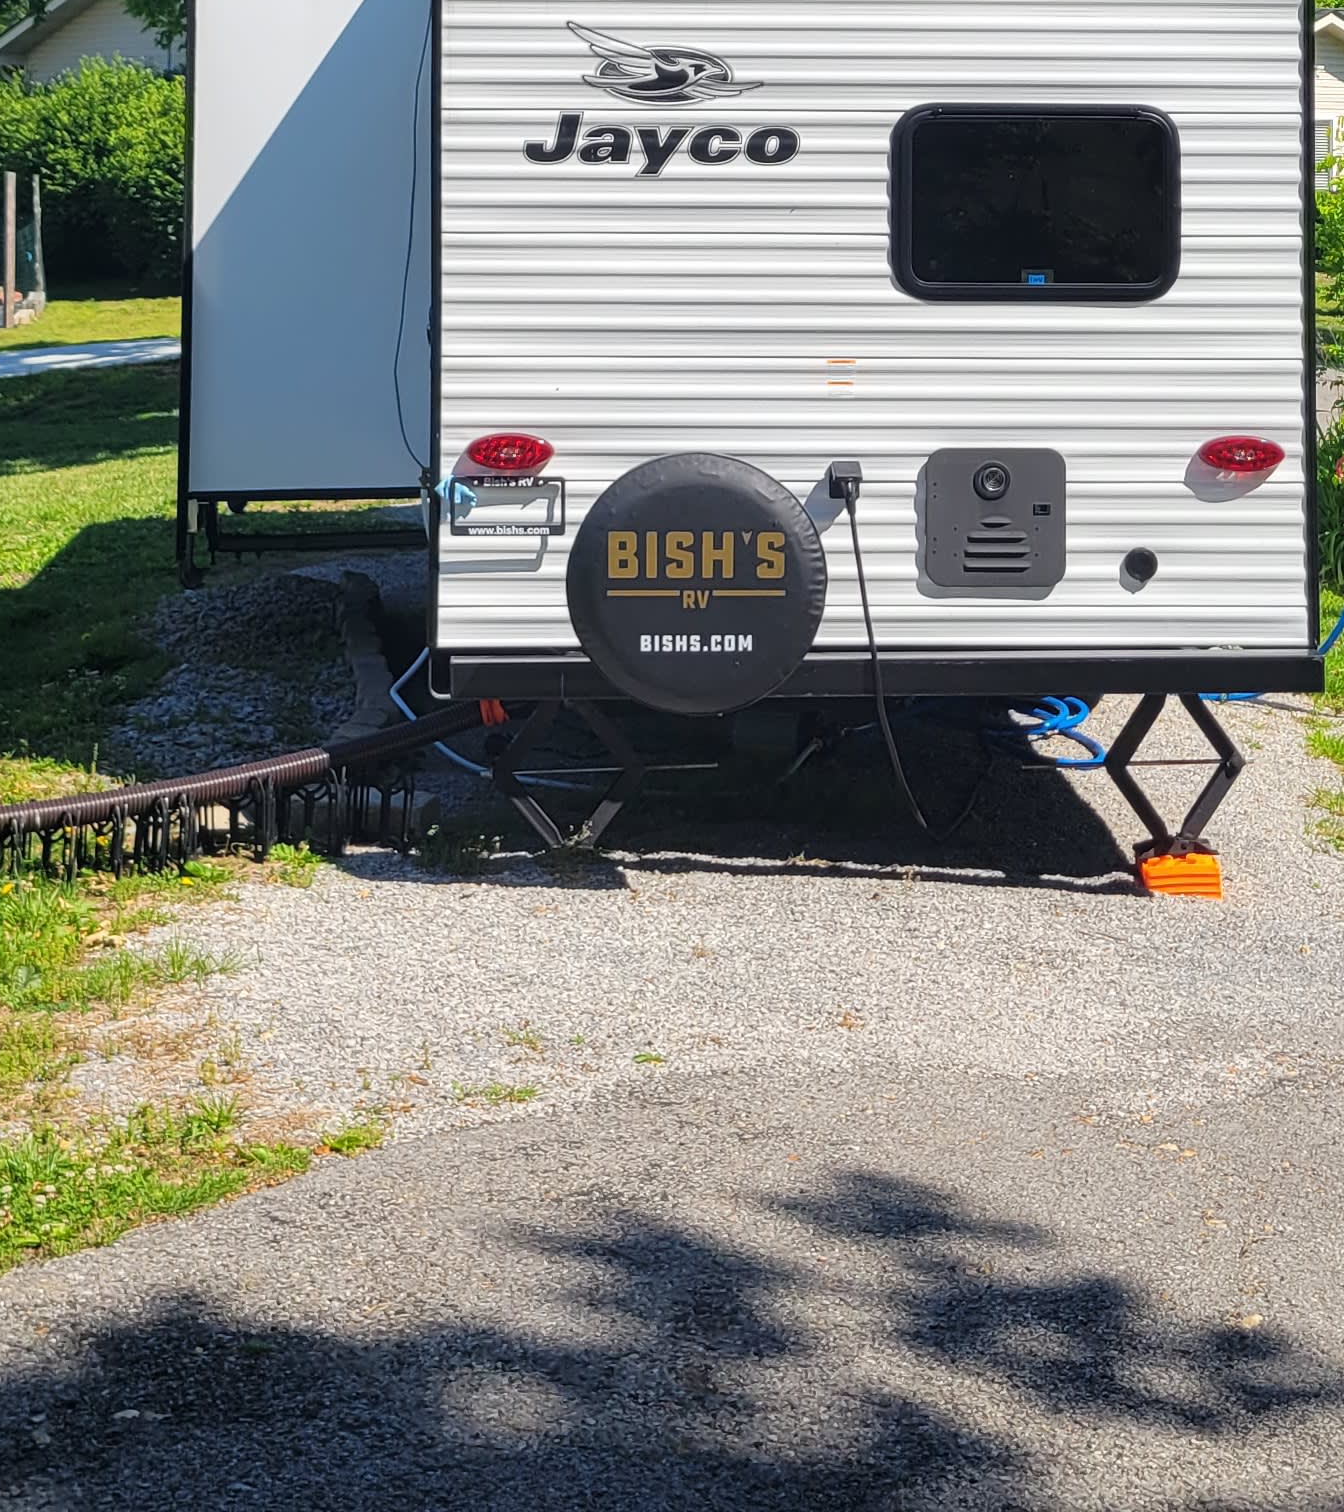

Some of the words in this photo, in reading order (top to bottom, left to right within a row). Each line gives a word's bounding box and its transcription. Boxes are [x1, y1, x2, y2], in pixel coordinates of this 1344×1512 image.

[523, 111, 801, 178] Jayco
[518, 477, 535, 487] RV
[468, 526, 551, 536] www.bishs.com
[608, 531, 786, 579] BISH'S
[682, 590, 710, 609] RV
[640, 635, 753, 652] BISHS.COM
